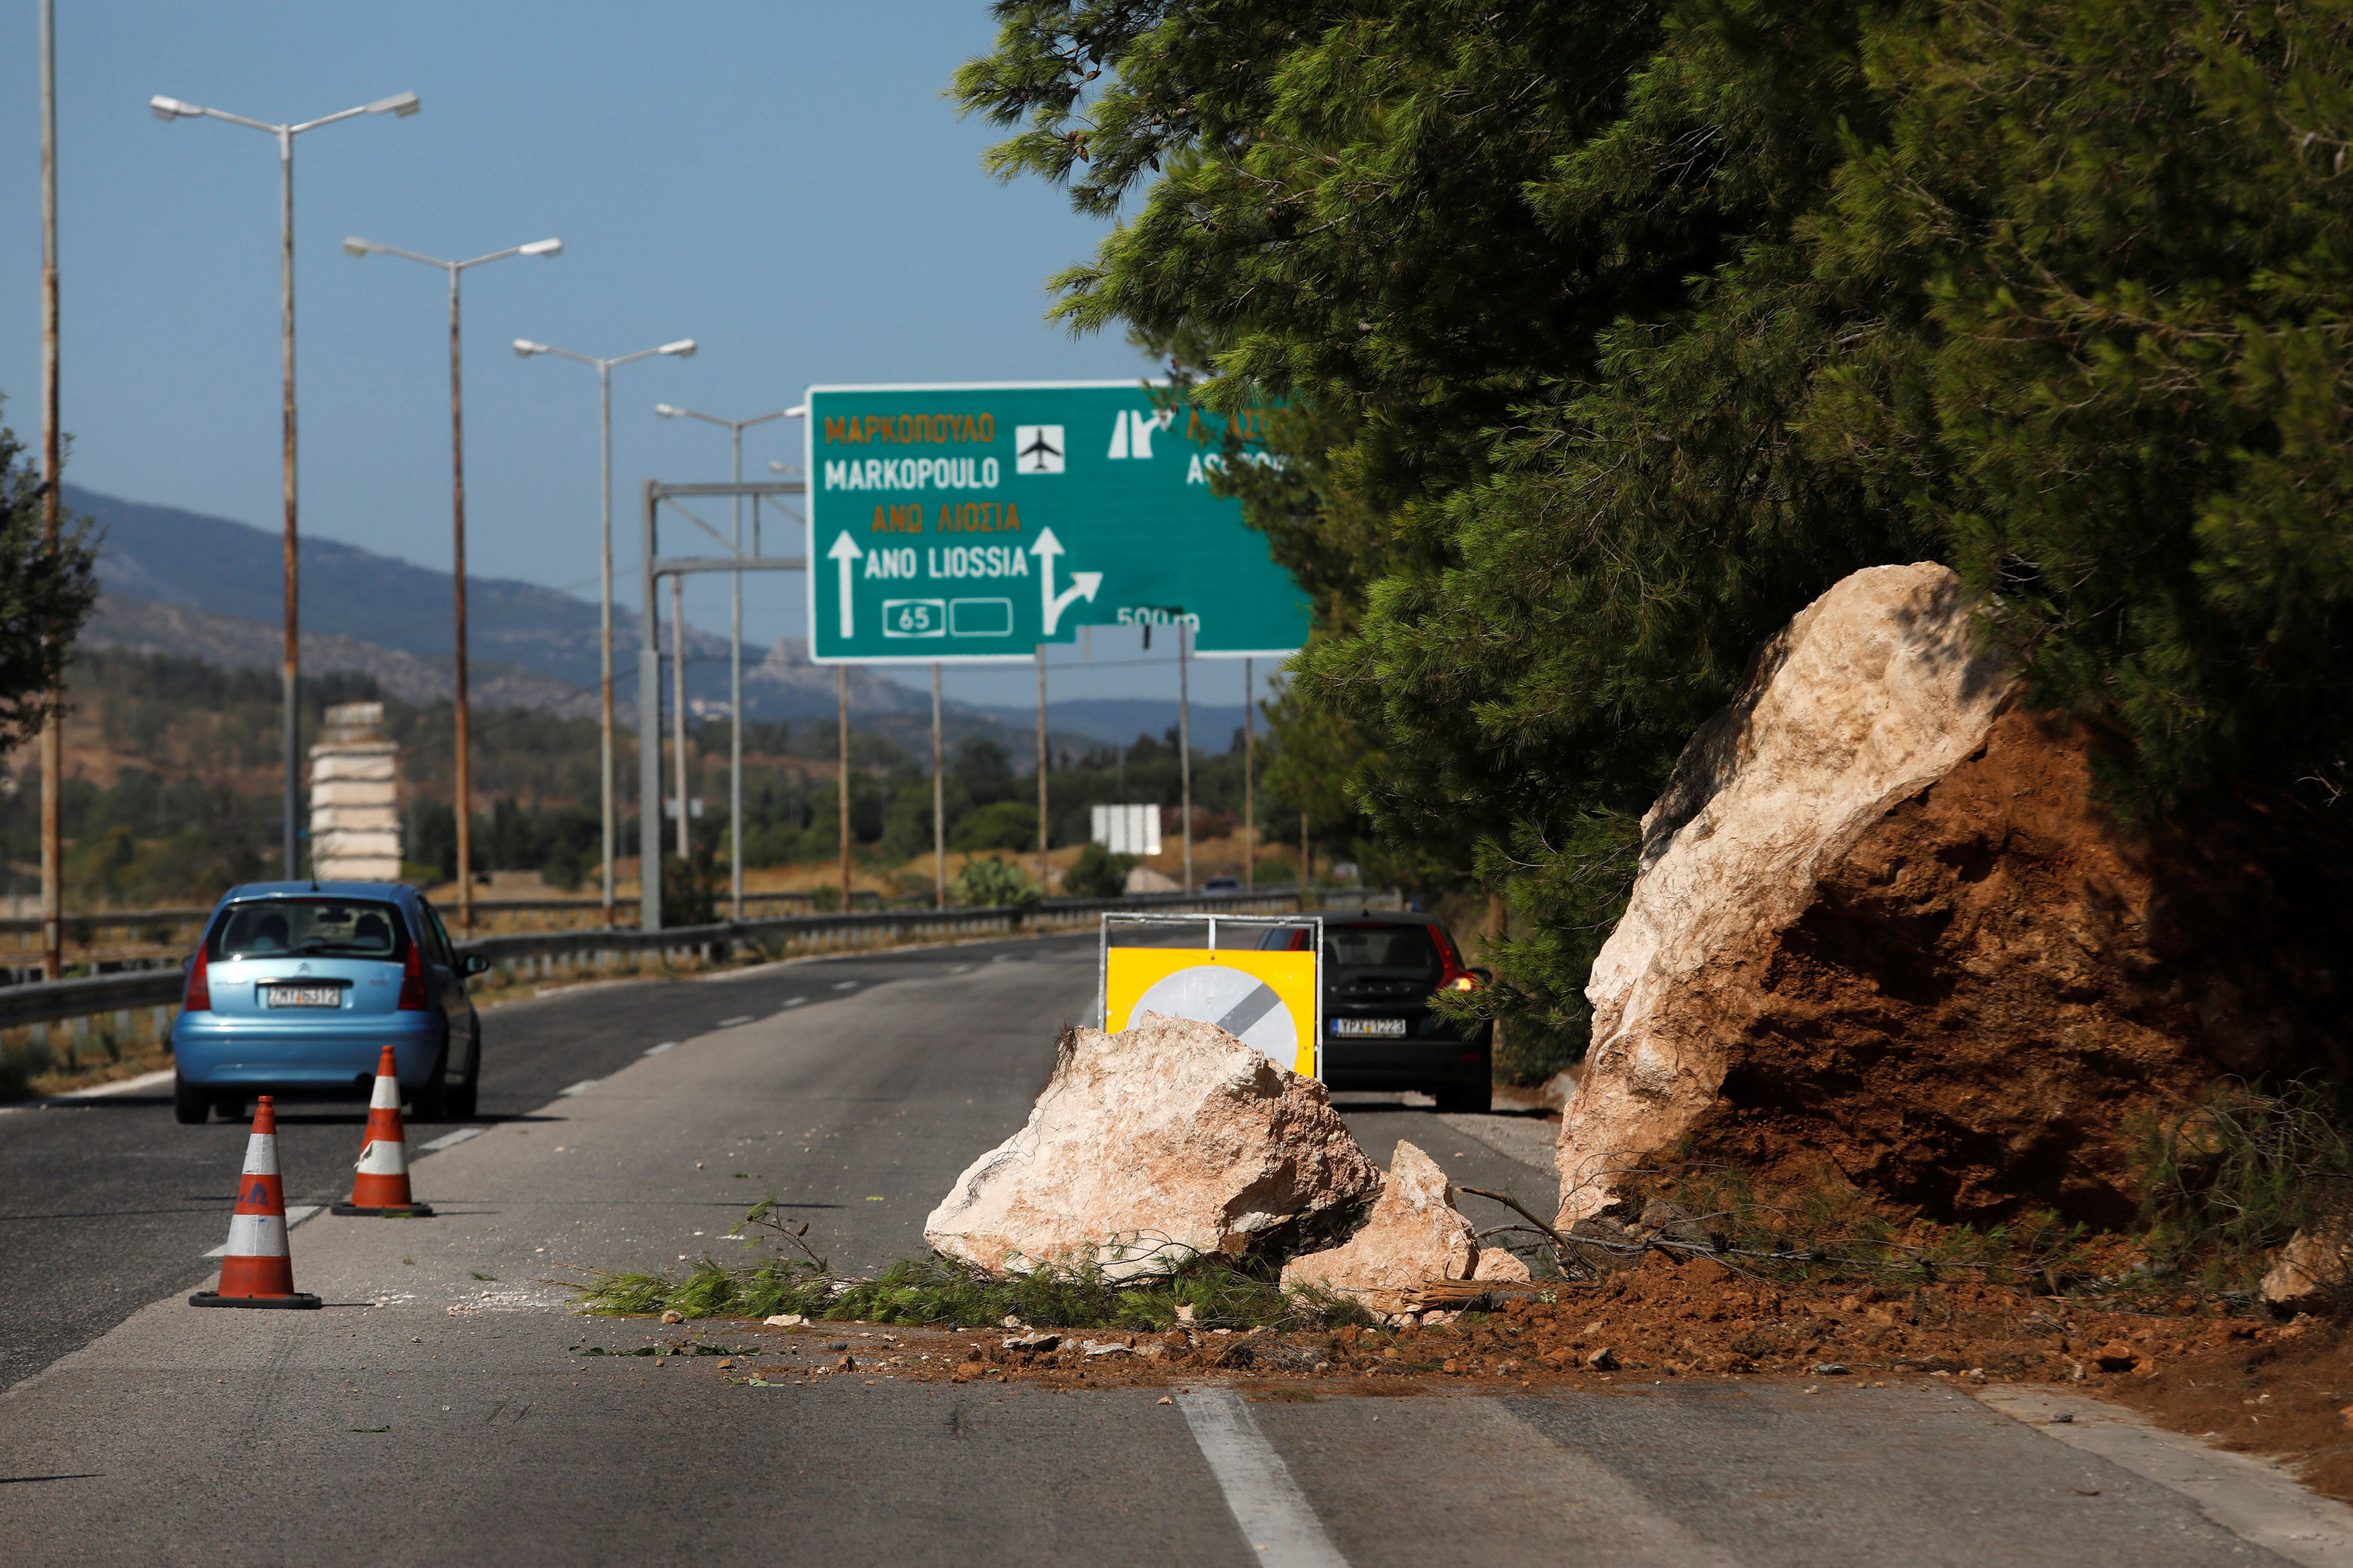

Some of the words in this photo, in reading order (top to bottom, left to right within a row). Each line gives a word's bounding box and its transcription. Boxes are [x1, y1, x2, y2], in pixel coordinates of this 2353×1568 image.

[824, 413, 995, 444] ΜΑΡΚΟΠΟΥΛΟ
[824, 457, 999, 491] MARKOPOULO
[871, 504, 923, 533] ΑΝΩ
[937, 502, 1021, 532] ΛΙΟΣΙΑ
[864, 547, 917, 579] ANO
[928, 546, 1029, 578] LIOSSIA
[899, 606, 930, 630] 65
